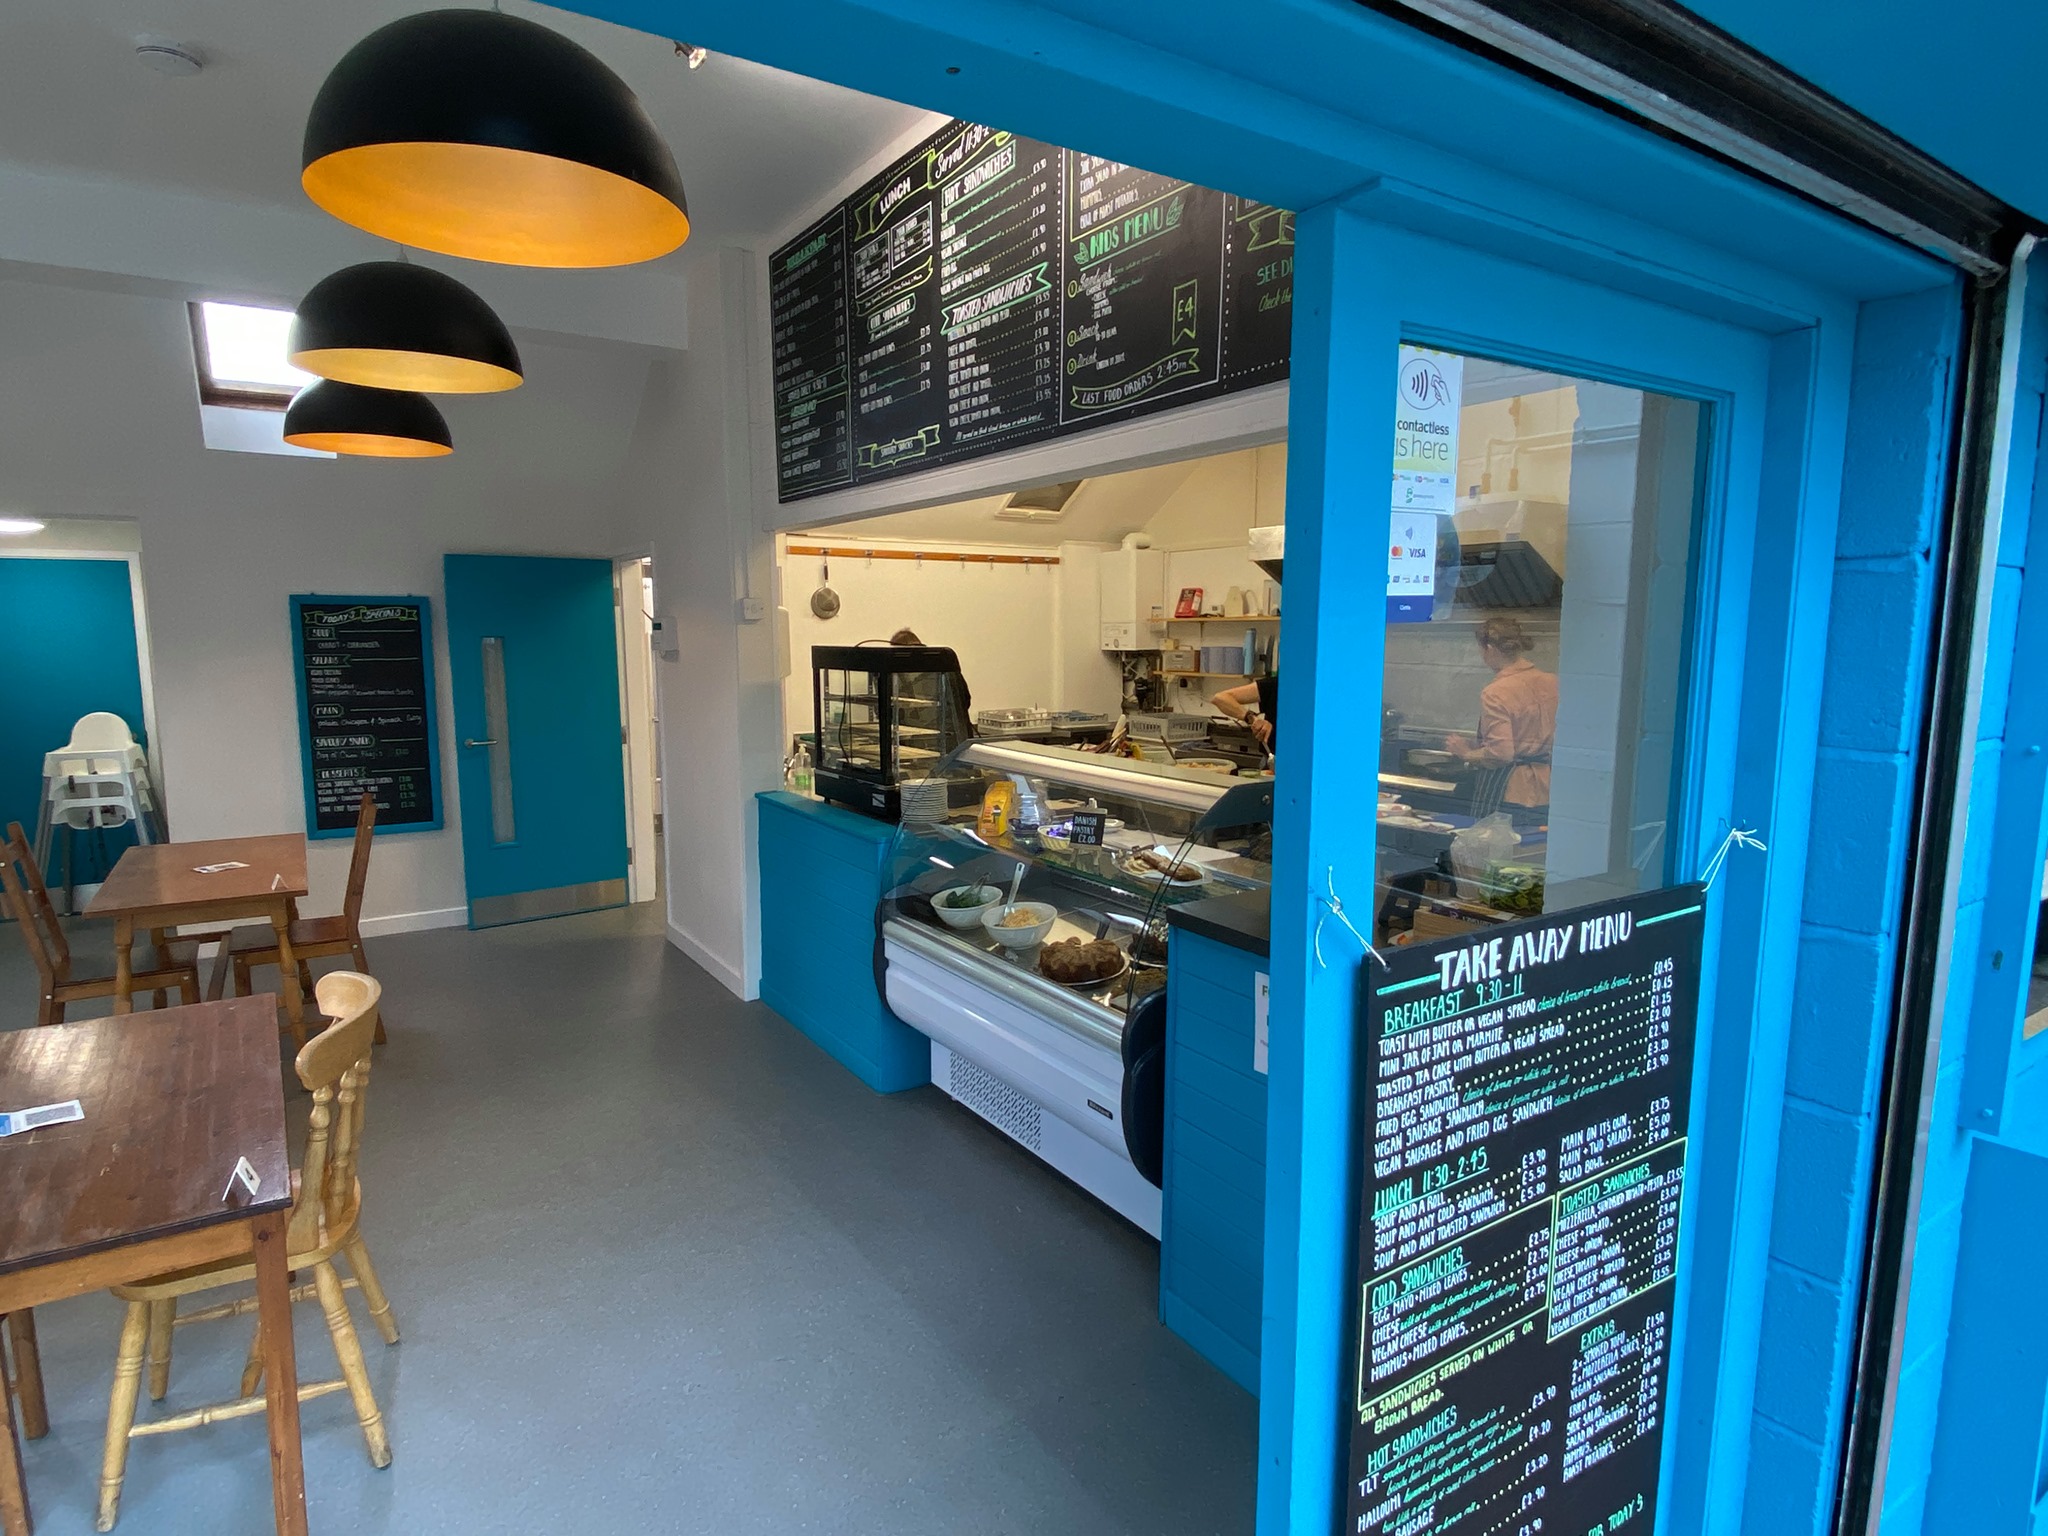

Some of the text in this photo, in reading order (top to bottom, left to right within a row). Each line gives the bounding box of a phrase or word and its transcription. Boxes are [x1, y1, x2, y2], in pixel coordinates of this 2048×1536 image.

[880, 176, 911, 214] LUNCH
[944, 146, 1012, 206] HOT SANDWICHES
[1090, 206, 1164, 259] KIDS MENU
[1257, 261, 1277, 285] SEE
[952, 273, 1032, 326] TOASTED SANDWICHES
[1177, 296, 1194, 322] £4
[1259, 288, 1280, 312] Check
[1082, 372, 1153, 404] LAST FOOD ORDERS
[1396, 434, 1448, 460] is here
[1397, 420, 1449, 435] contactless
[1409, 548, 1426, 558] VISA
[1073, 826, 1094, 835] PASTRY
[1075, 816, 1097, 825] DANISH
[1078, 834, 1095, 843] £2.00
[1435, 911, 1631, 990] TAKE AWAY MENU
[1378, 1035, 1406, 1056] TOAST
[1409, 1029, 1429, 1049] WITH
[1433, 1019, 1463, 1041] BUTTER
[1465, 1017, 1475, 1031] OR
[1478, 1008, 1503, 1029] VEGAN
[1507, 999, 1536, 1019] SPREAD
[1654, 957, 1673, 976] £0.45
[1384, 989, 1464, 1033] BREAKFAST
[1376, 1024, 1565, 1098] TOASTED TEA CAKE WITH BUTTER OR VEGAN SPREAD
[1377, 1005, 1671, 1118] BREAKFAST PASTRY £2.00
[1379, 1026, 1503, 1077] MINI JAR OF JAM OR MARMITE
[1374, 1054, 1669, 1178] VEGAN SAUSAGE AND FRIED EGG SANDWICH £3.90
[1374, 1100, 1484, 1158] VEGAN SAUSAGE SANDWICH
[1376, 1093, 1459, 1138] FRIED EGG SANDWICH
[1561, 1096, 1670, 1153] MAIN ON OWN £3.75
[1559, 1113, 1671, 1169] MAIN TWO SALADS £5.00
[1374, 1149, 1546, 1233] SOUP AND A ROLL £3.90
[1559, 1157, 1604, 1183] SALAD BOWL
[1561, 1163, 1650, 1215] TOASTED SANDWICHES
[1374, 1177, 1413, 1216] LUNCH
[1374, 1164, 1547, 1250] SOUP AND ANY COLD SANDWICH £5.50
[1374, 1182, 1546, 1271] SOUP AND ANY TOASTED SANDWICH £5.80
[1554, 1185, 1679, 1251] CHEESE TOMATO £3.00
[1372, 1246, 1464, 1311] COLD SANDWICHES
[1373, 1228, 1549, 1326] EGG £2.75
[1554, 1247, 1579, 1268] CHEESE
[1372, 1246, 1549, 1346] CHEESE £2.75
[1524, 1280, 1546, 1301] £2.75
[1553, 1257, 1625, 1301] VEGAN CHEESE TOMATO
[1371, 1264, 1548, 1364] VEGAN CHEESE £3.00
[1552, 1287, 1594, 1318] VEGAN CHEESE
[1646, 1311, 1665, 1330] £1.50
[1551, 1315, 1570, 1336] VEGAN
[1581, 1319, 1615, 1349] EXTRAS
[1645, 1327, 1664, 1345] £1.50
[1361, 1321, 1533, 1424] ALL SANDWICHES SERVED ON WHITE OR
[1570, 1378, 1591, 1400] VEGAN
[1374, 1407, 1408, 1434] BROWN
[1569, 1391, 1602, 1418] FRIED EGG
[1367, 1405, 1458, 1474] HOT SANDWICHES
[1358, 1473, 1379, 1497] TLT
[1563, 1459, 1583, 1483] ROAST
[1357, 1492, 1401, 1533] HALLOUMI
